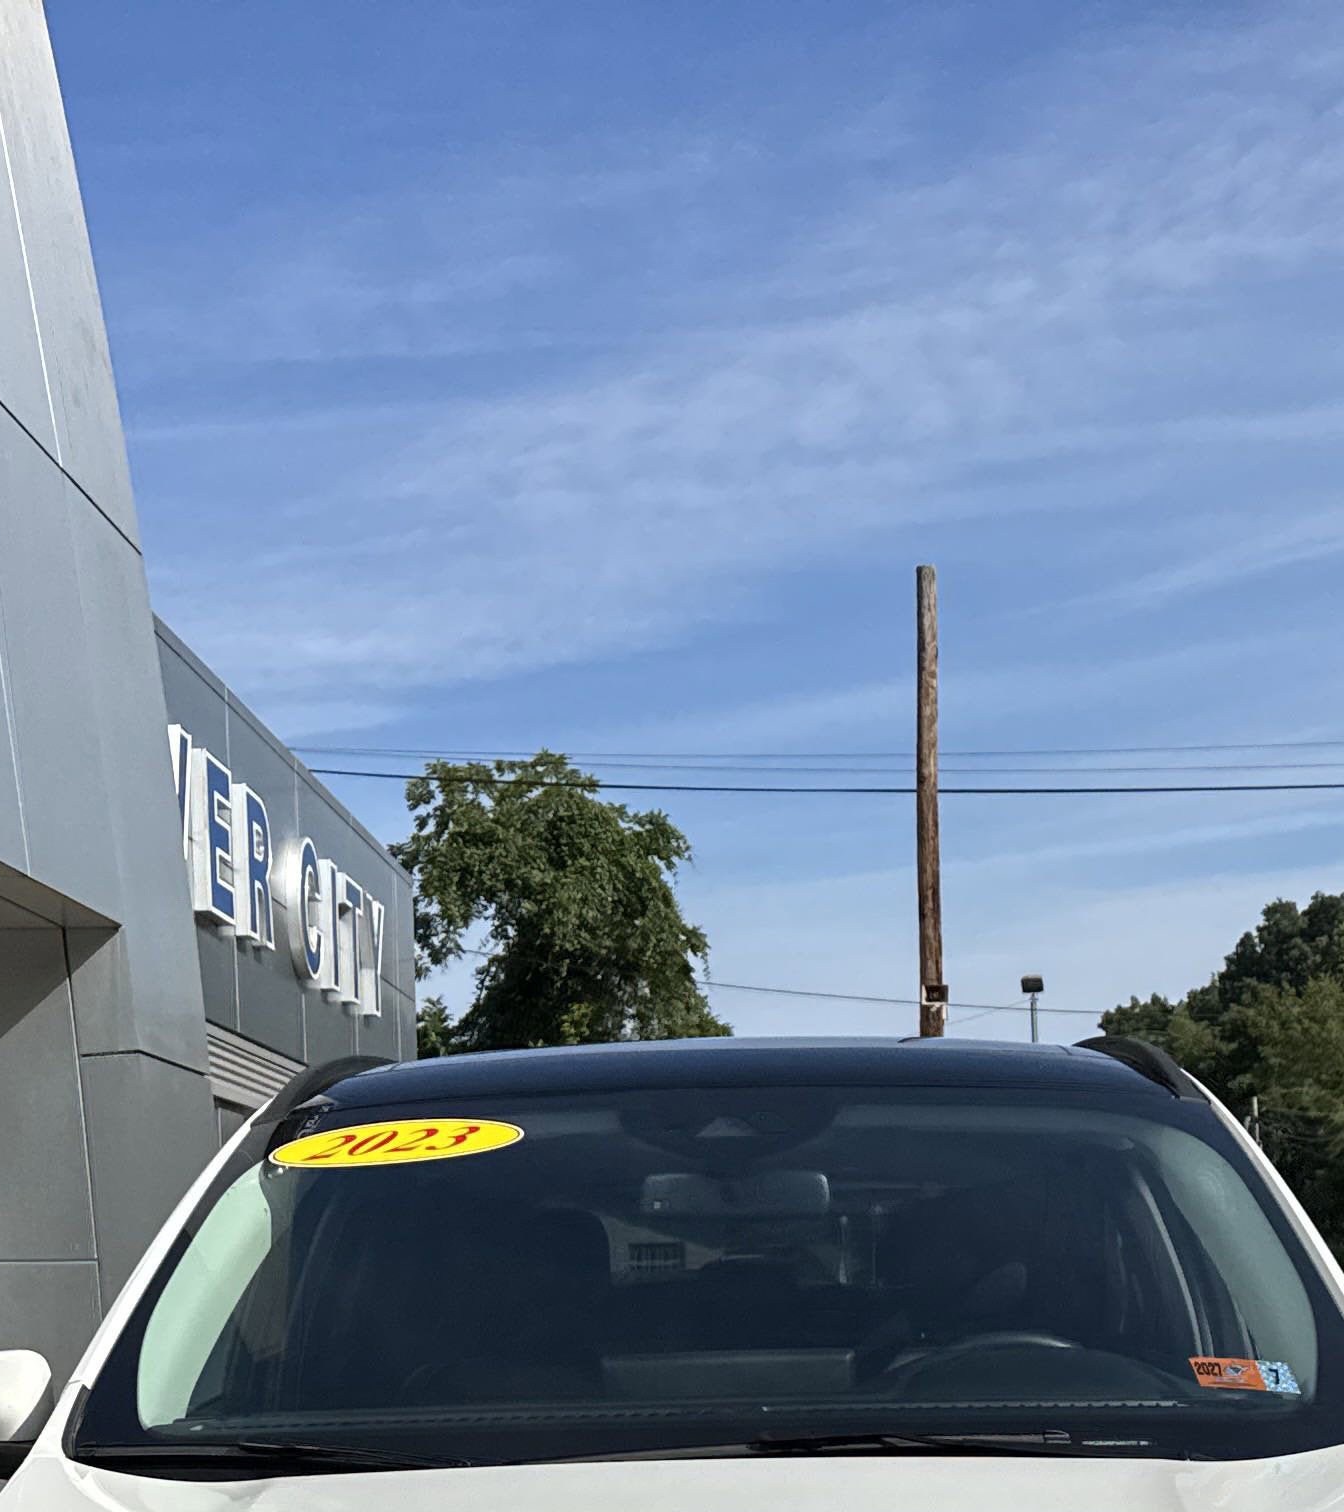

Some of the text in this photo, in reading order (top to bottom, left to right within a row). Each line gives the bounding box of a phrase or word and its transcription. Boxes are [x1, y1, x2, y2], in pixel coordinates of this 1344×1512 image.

[287, 836, 386, 1018] CITY
[301, 1126, 481, 1161] 2023
[1194, 1361, 1223, 1377] 2027
[1268, 1368, 1280, 1385] 7
